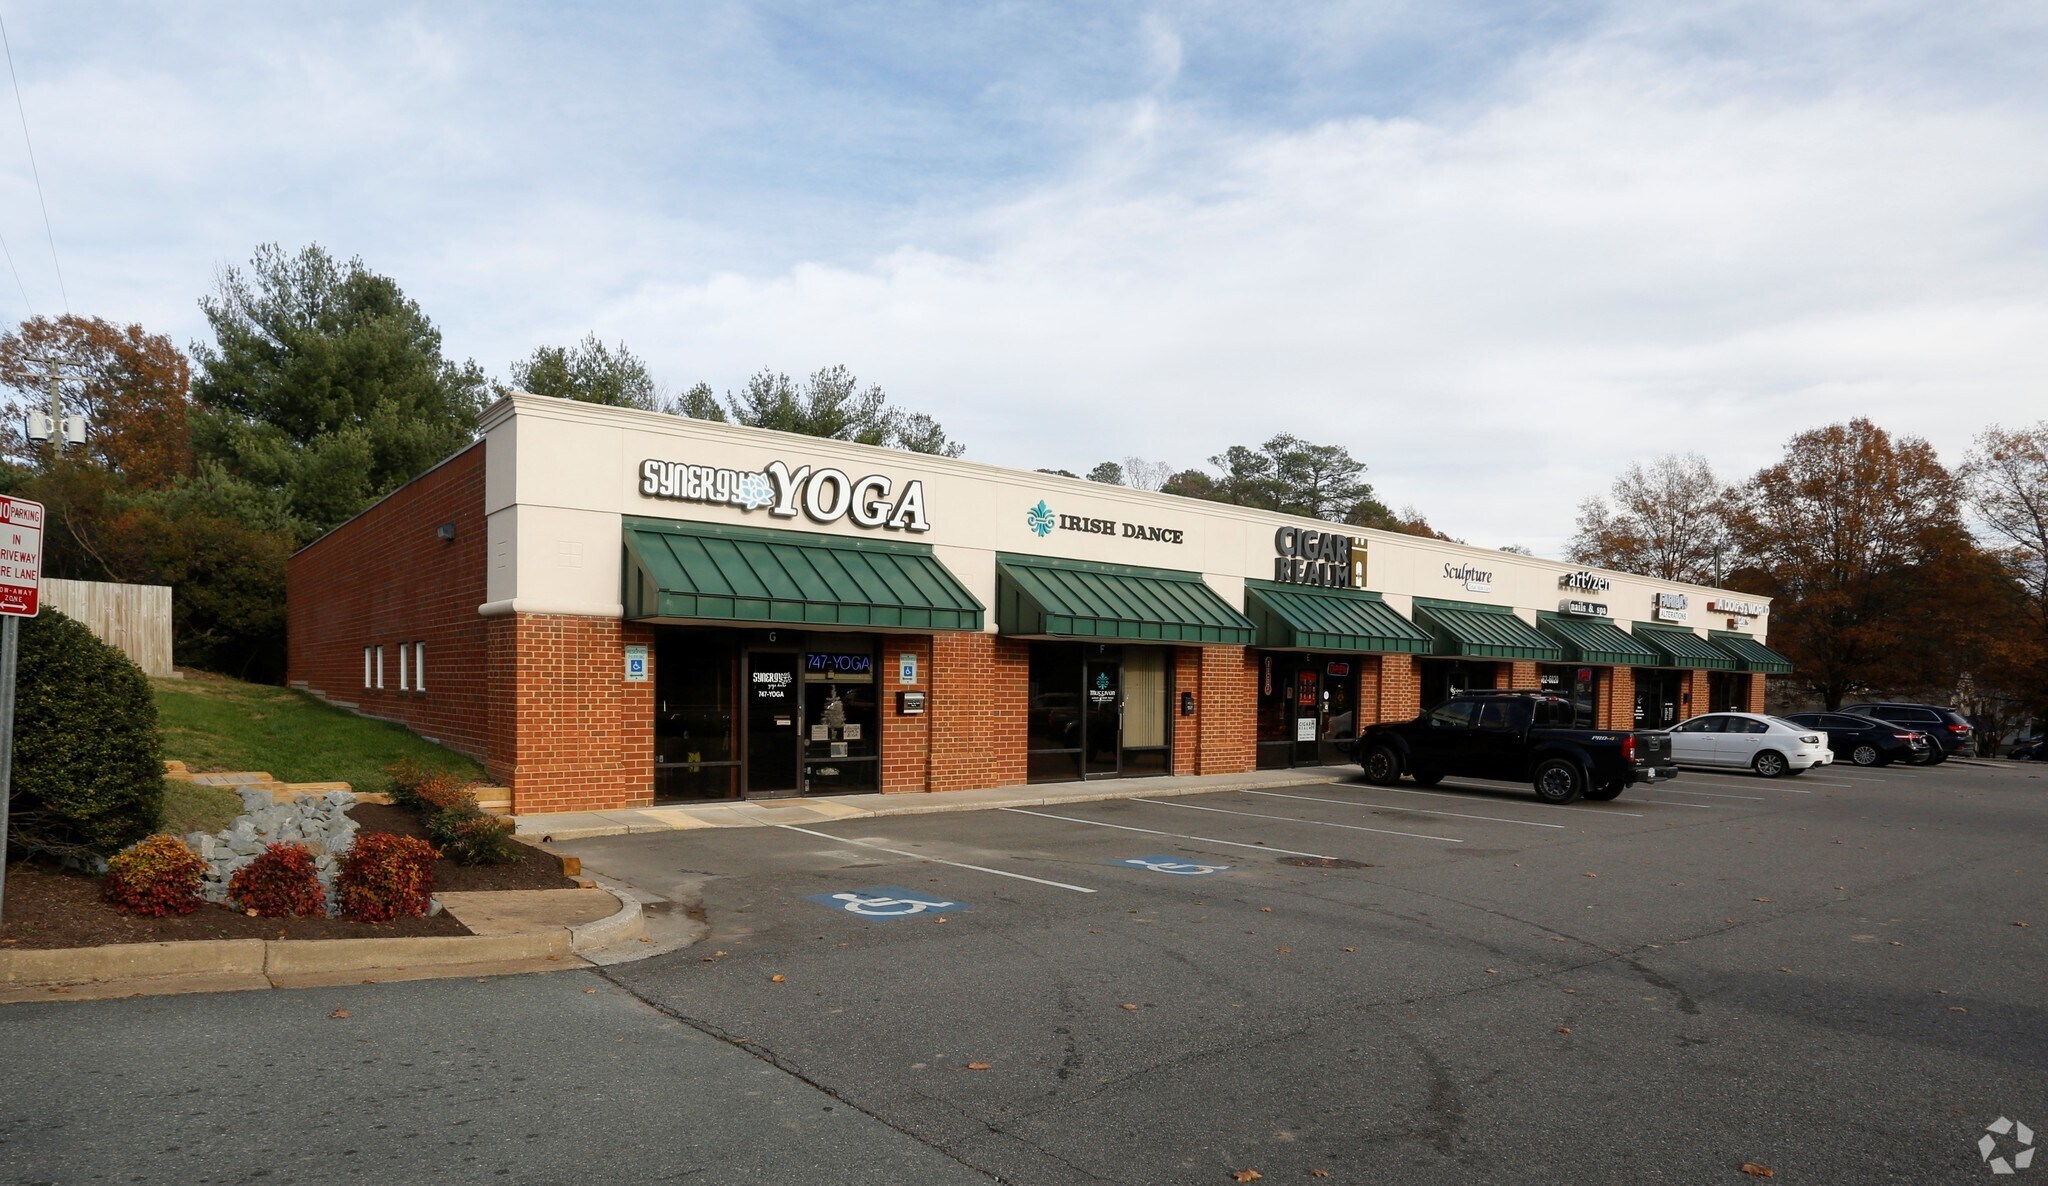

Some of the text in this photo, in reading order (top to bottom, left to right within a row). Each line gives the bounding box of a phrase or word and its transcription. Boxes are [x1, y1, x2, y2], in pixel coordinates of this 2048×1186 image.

[765, 460, 930, 531] YOGA
[11, 507, 39, 522] PARKING
[1059, 514, 1183, 544] IRISH DANCE
[13, 534, 21, 545] IN
[1275, 526, 1348, 563] CIGAR
[0, 549, 36, 564] RIVEWAY
[0, 566, 36, 580] RE LANE
[1275, 557, 1349, 587] REALM
[1443, 562, 1492, 586] Sculpture
[0, 587, 32, 596] OW-AWAY
[1570, 602, 1607, 616] nails & spa
[770, 632, 776, 641] G
[807, 654, 870, 670] 747-YOGA
